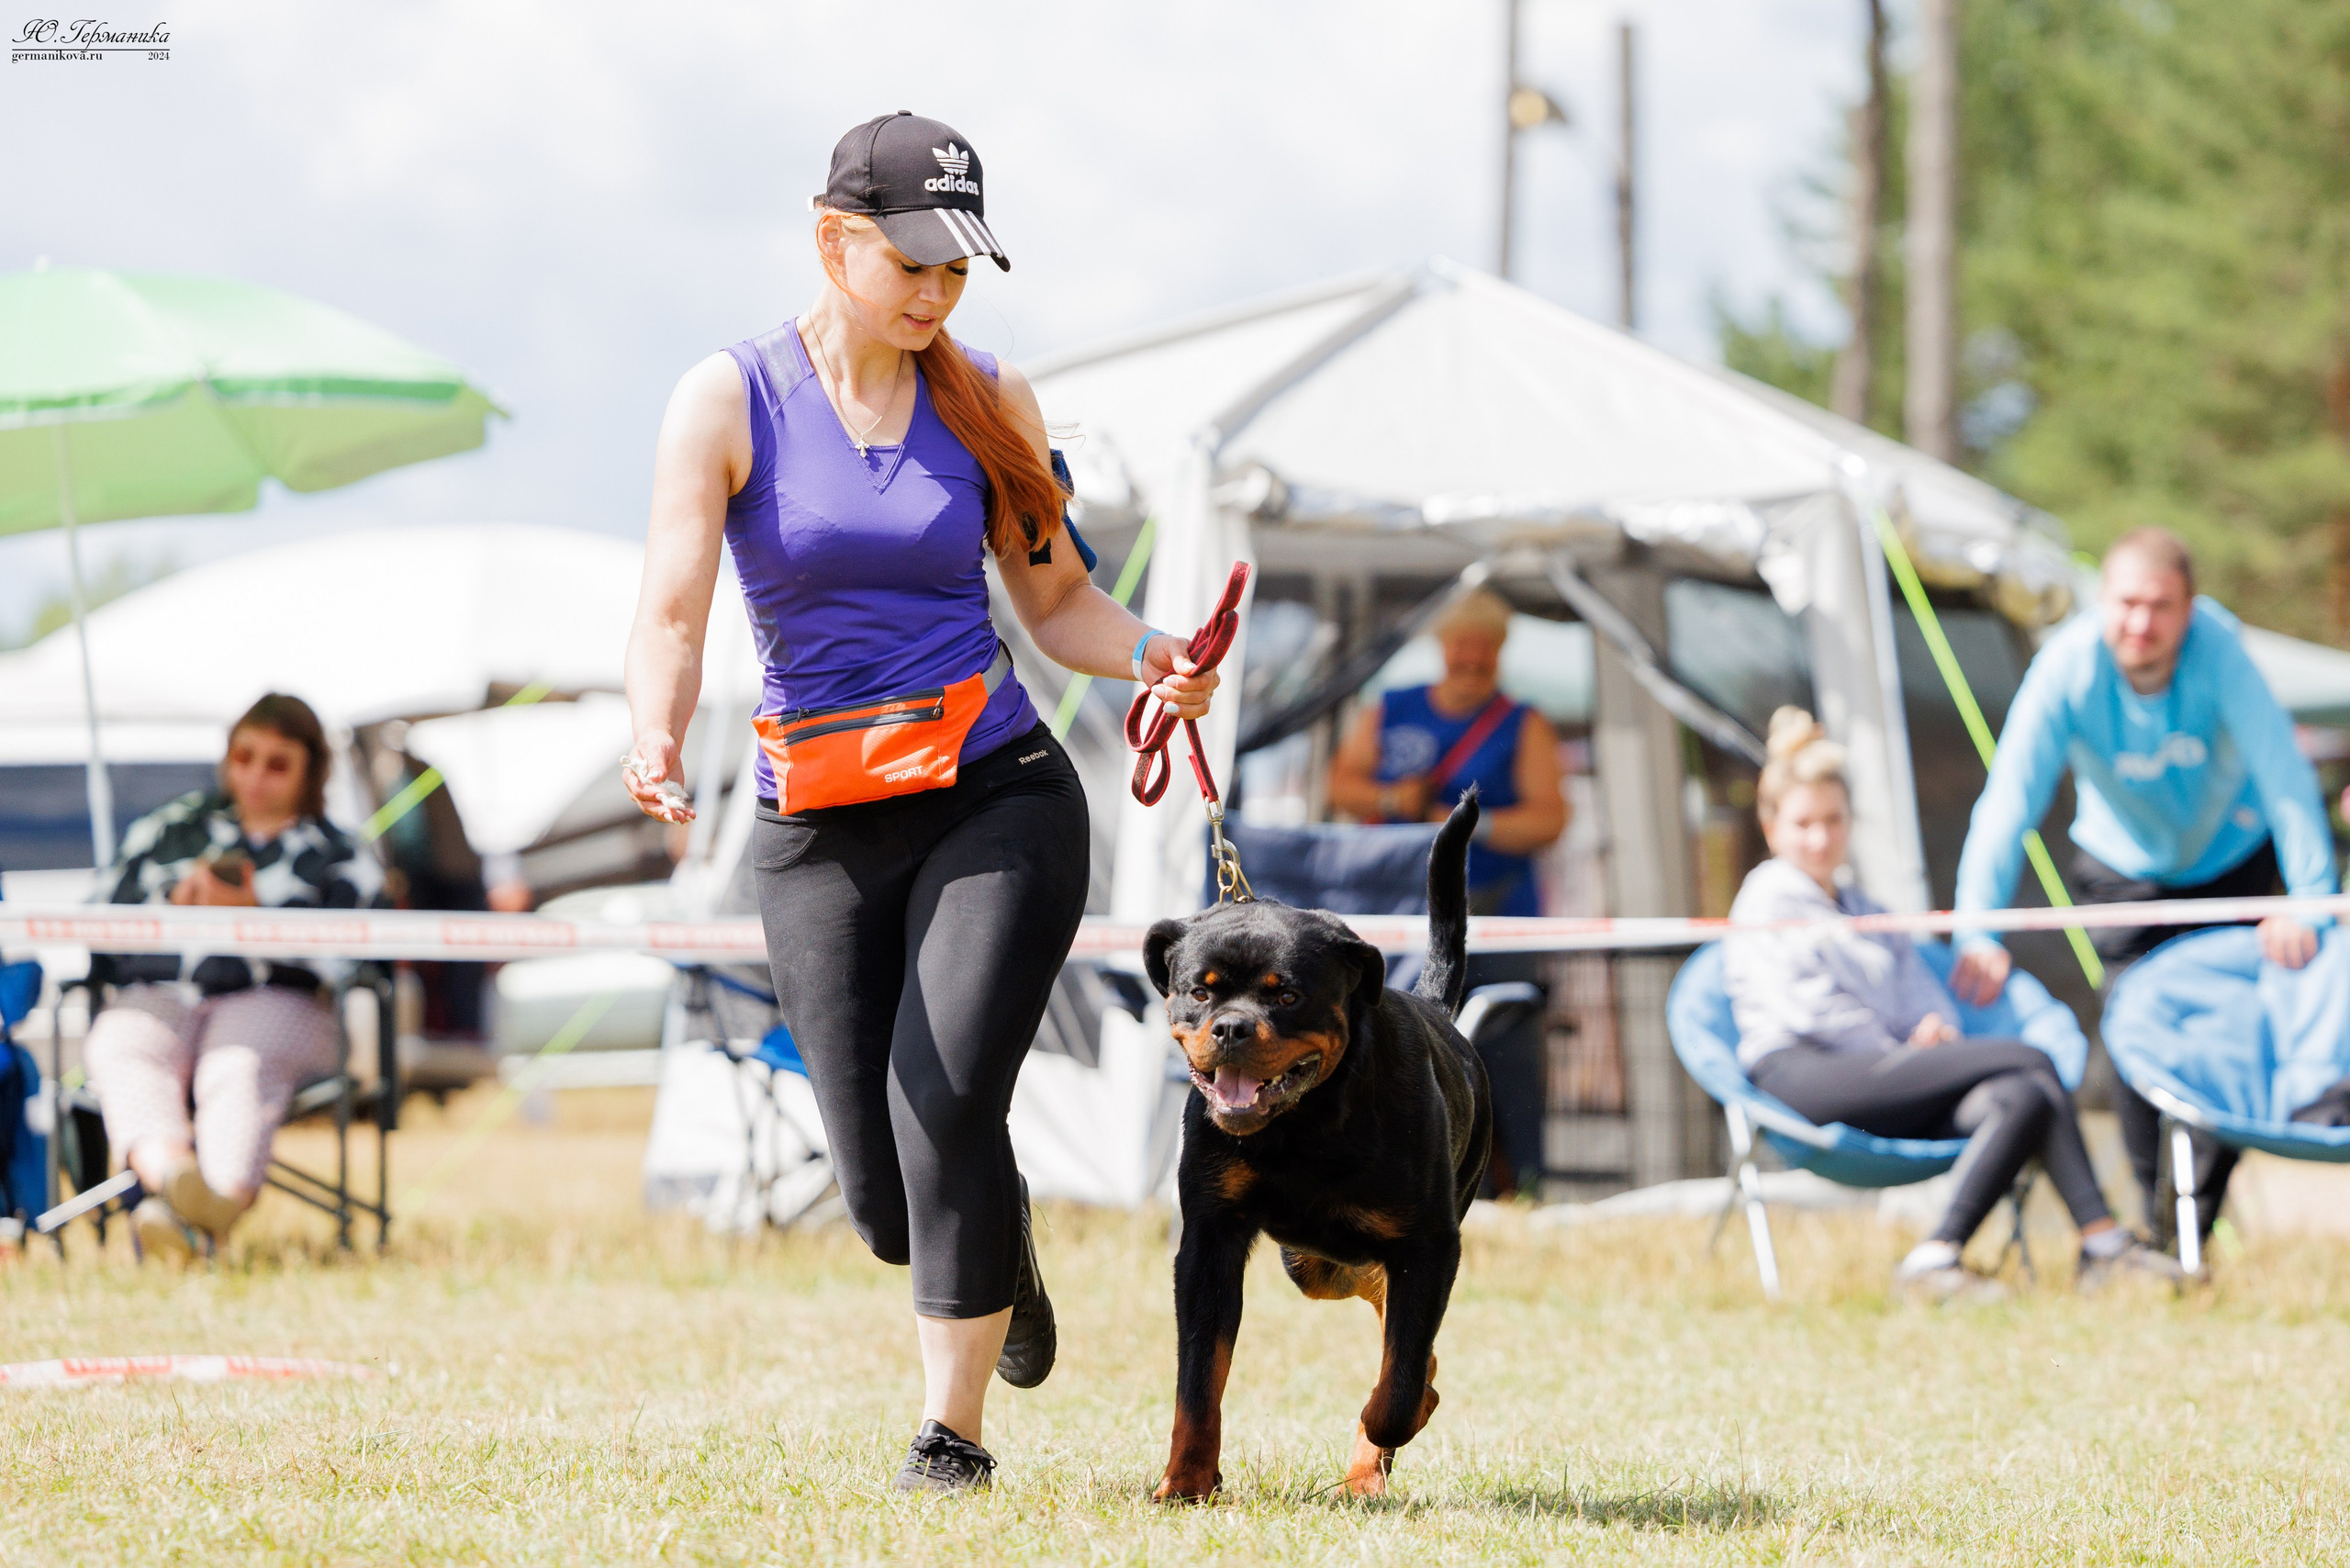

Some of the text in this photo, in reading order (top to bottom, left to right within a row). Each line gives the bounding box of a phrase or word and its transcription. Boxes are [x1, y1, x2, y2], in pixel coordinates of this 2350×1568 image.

[924, 174, 979, 196] adidas
[1018, 749, 1048, 765] Reebok
[884, 765, 923, 783] SPORT
